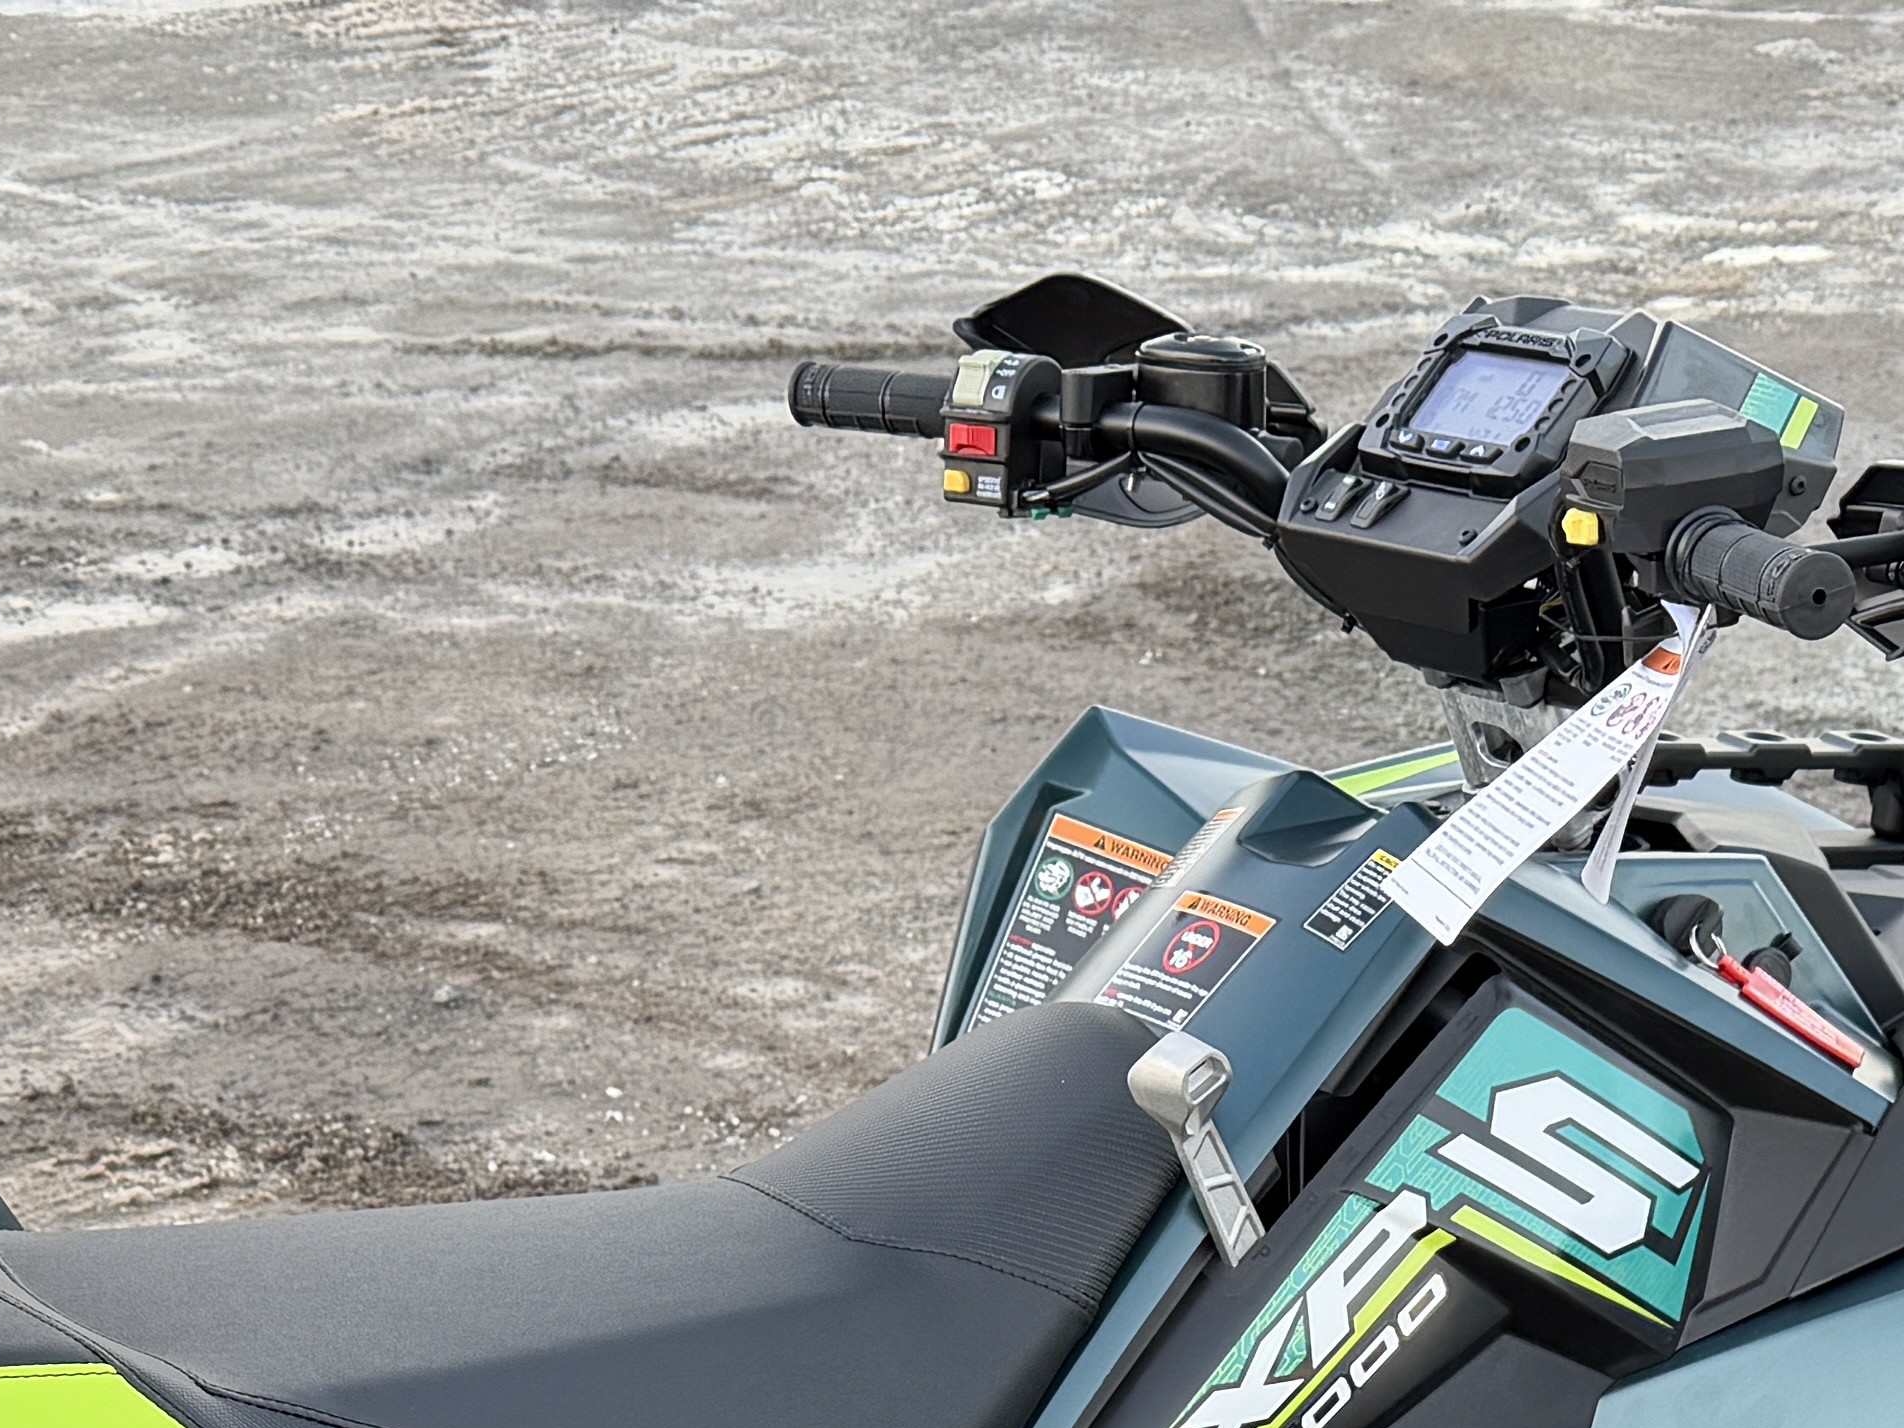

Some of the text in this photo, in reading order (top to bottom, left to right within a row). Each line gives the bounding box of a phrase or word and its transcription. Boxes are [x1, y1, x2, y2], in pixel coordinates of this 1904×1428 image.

[1484, 328, 1558, 348] POLARIS
[1200, 898, 1251, 926] WARNING
[1436, 1075, 1701, 1255] S
